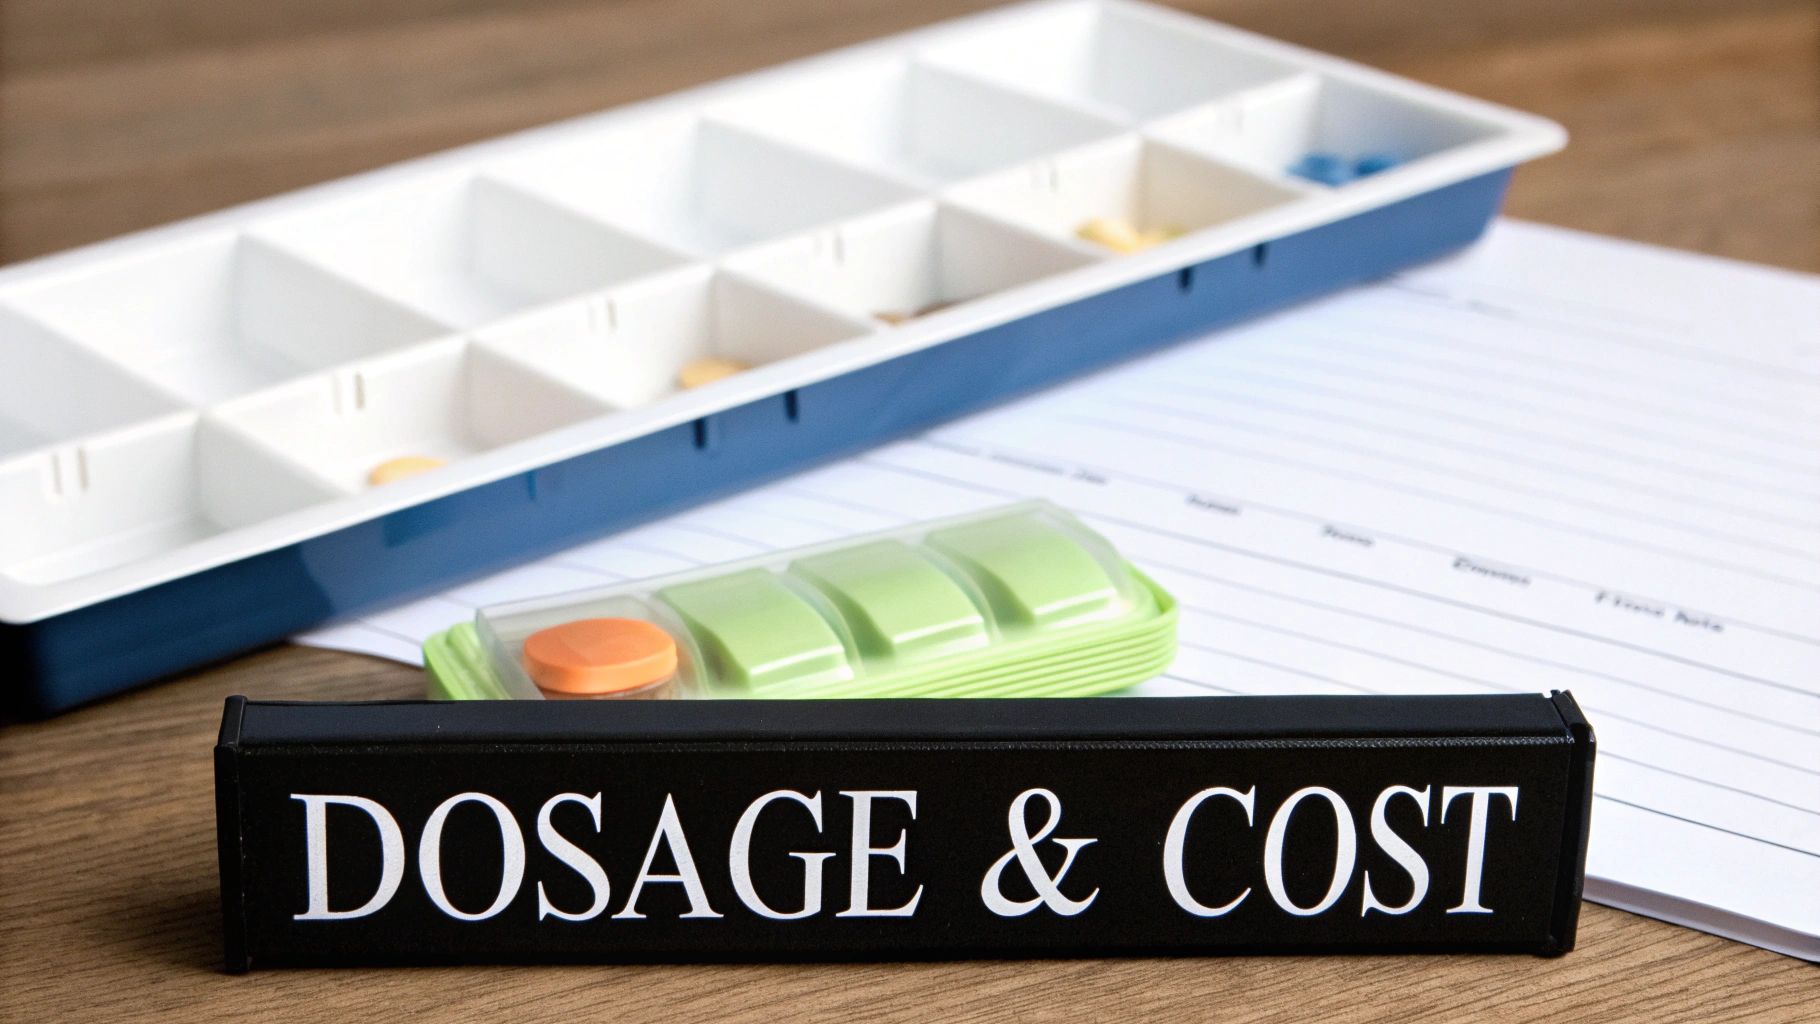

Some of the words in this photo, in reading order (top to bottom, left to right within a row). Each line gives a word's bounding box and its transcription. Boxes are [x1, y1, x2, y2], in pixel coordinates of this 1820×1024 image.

[290, 789, 924, 922] DOSAGE
[980, 787, 1100, 918] &
[1163, 784, 1519, 918] COST
